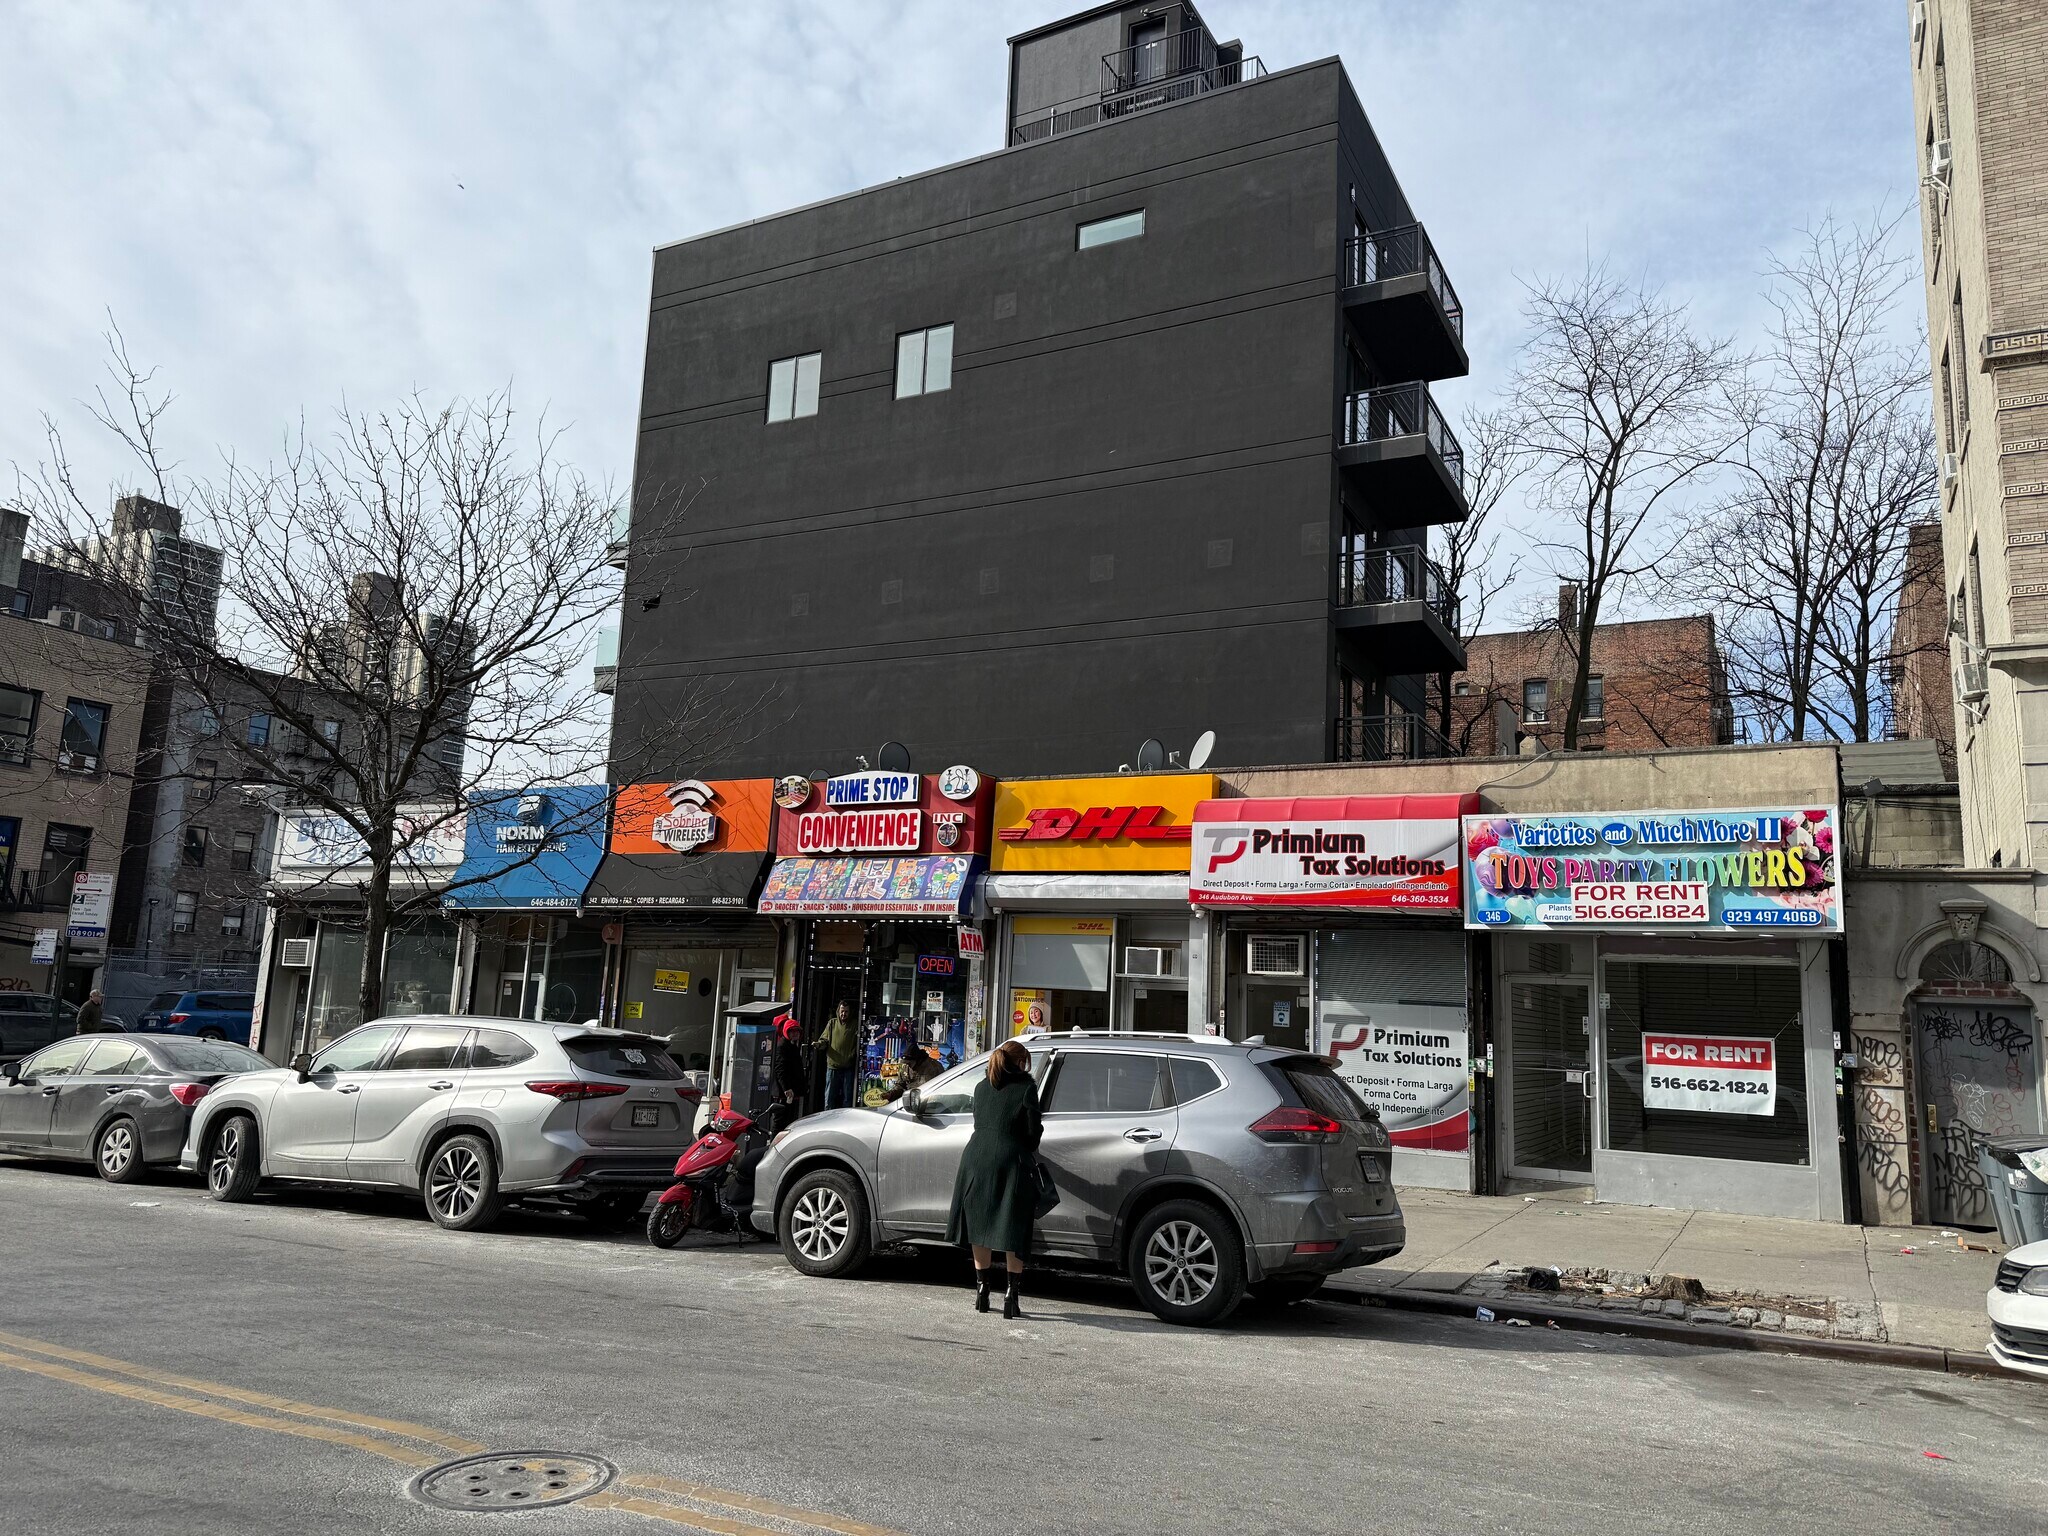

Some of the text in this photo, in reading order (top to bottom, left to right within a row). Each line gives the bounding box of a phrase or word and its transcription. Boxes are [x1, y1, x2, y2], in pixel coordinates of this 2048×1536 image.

[827, 776, 918, 803] PRIME STOP 1
[934, 814, 963, 823] INC
[1023, 806, 1173, 840] DHL
[496, 825, 545, 841] NORM
[664, 829, 706, 841] WIRELESS
[800, 812, 918, 849] CONVENIENCE
[1512, 817, 1781, 846] Varieties and Much More II
[496, 842, 567, 853] HAIR EXTESIONS
[1252, 828, 1366, 854] Primium
[1299, 855, 1446, 876] Tax Solutions
[1490, 846, 1806, 889] TOYS PARTY FLOWERS
[1203, 880, 1448, 891] Direct Deposit Forma Larga Forma Corta Empleado Independiente
[1574, 884, 1705, 901] FOR RENT
[75, 895, 82, 903] 2
[530, 898, 578, 907] 646-484-6177
[711, 897, 744, 905] 646-823-9101
[1391, 895, 1449, 904] 646-360-3534
[774, 903, 800, 911] GROCERY
[803, 903, 825, 911] SNACKS
[828, 903, 848, 911] SODAS
[851, 903, 884, 911] HOUSEHOLD
[885, 903, 918, 911] ESSENTIALS
[923, 903, 935, 911] ATM
[936, 903, 956, 911] INSIDE
[1548, 904, 1572, 912] Plants
[1575, 904, 1706, 919] 516.662.1824
[1485, 911, 1501, 921] 346
[1726, 911, 1817, 922] 929 497 4068
[1077, 922, 1105, 930] DHL
[961, 933, 983, 952] ATM
[920, 957, 953, 973] OPEN
[1374, 1028, 1450, 1048] Primium
[1363, 1049, 1462, 1068] Tax Solutions
[1651, 1043, 1765, 1064] FOR RENT
[1356, 1075, 1389, 1086] Deposit
[1397, 1078, 1425, 1088] Forma
[1427, 1080, 1453, 1092] Larga
[1650, 1076, 1770, 1095] 516-662-1824
[1363, 1088, 1417, 1100] Forma Corta
[1382, 1102, 1445, 1116] Independiente
